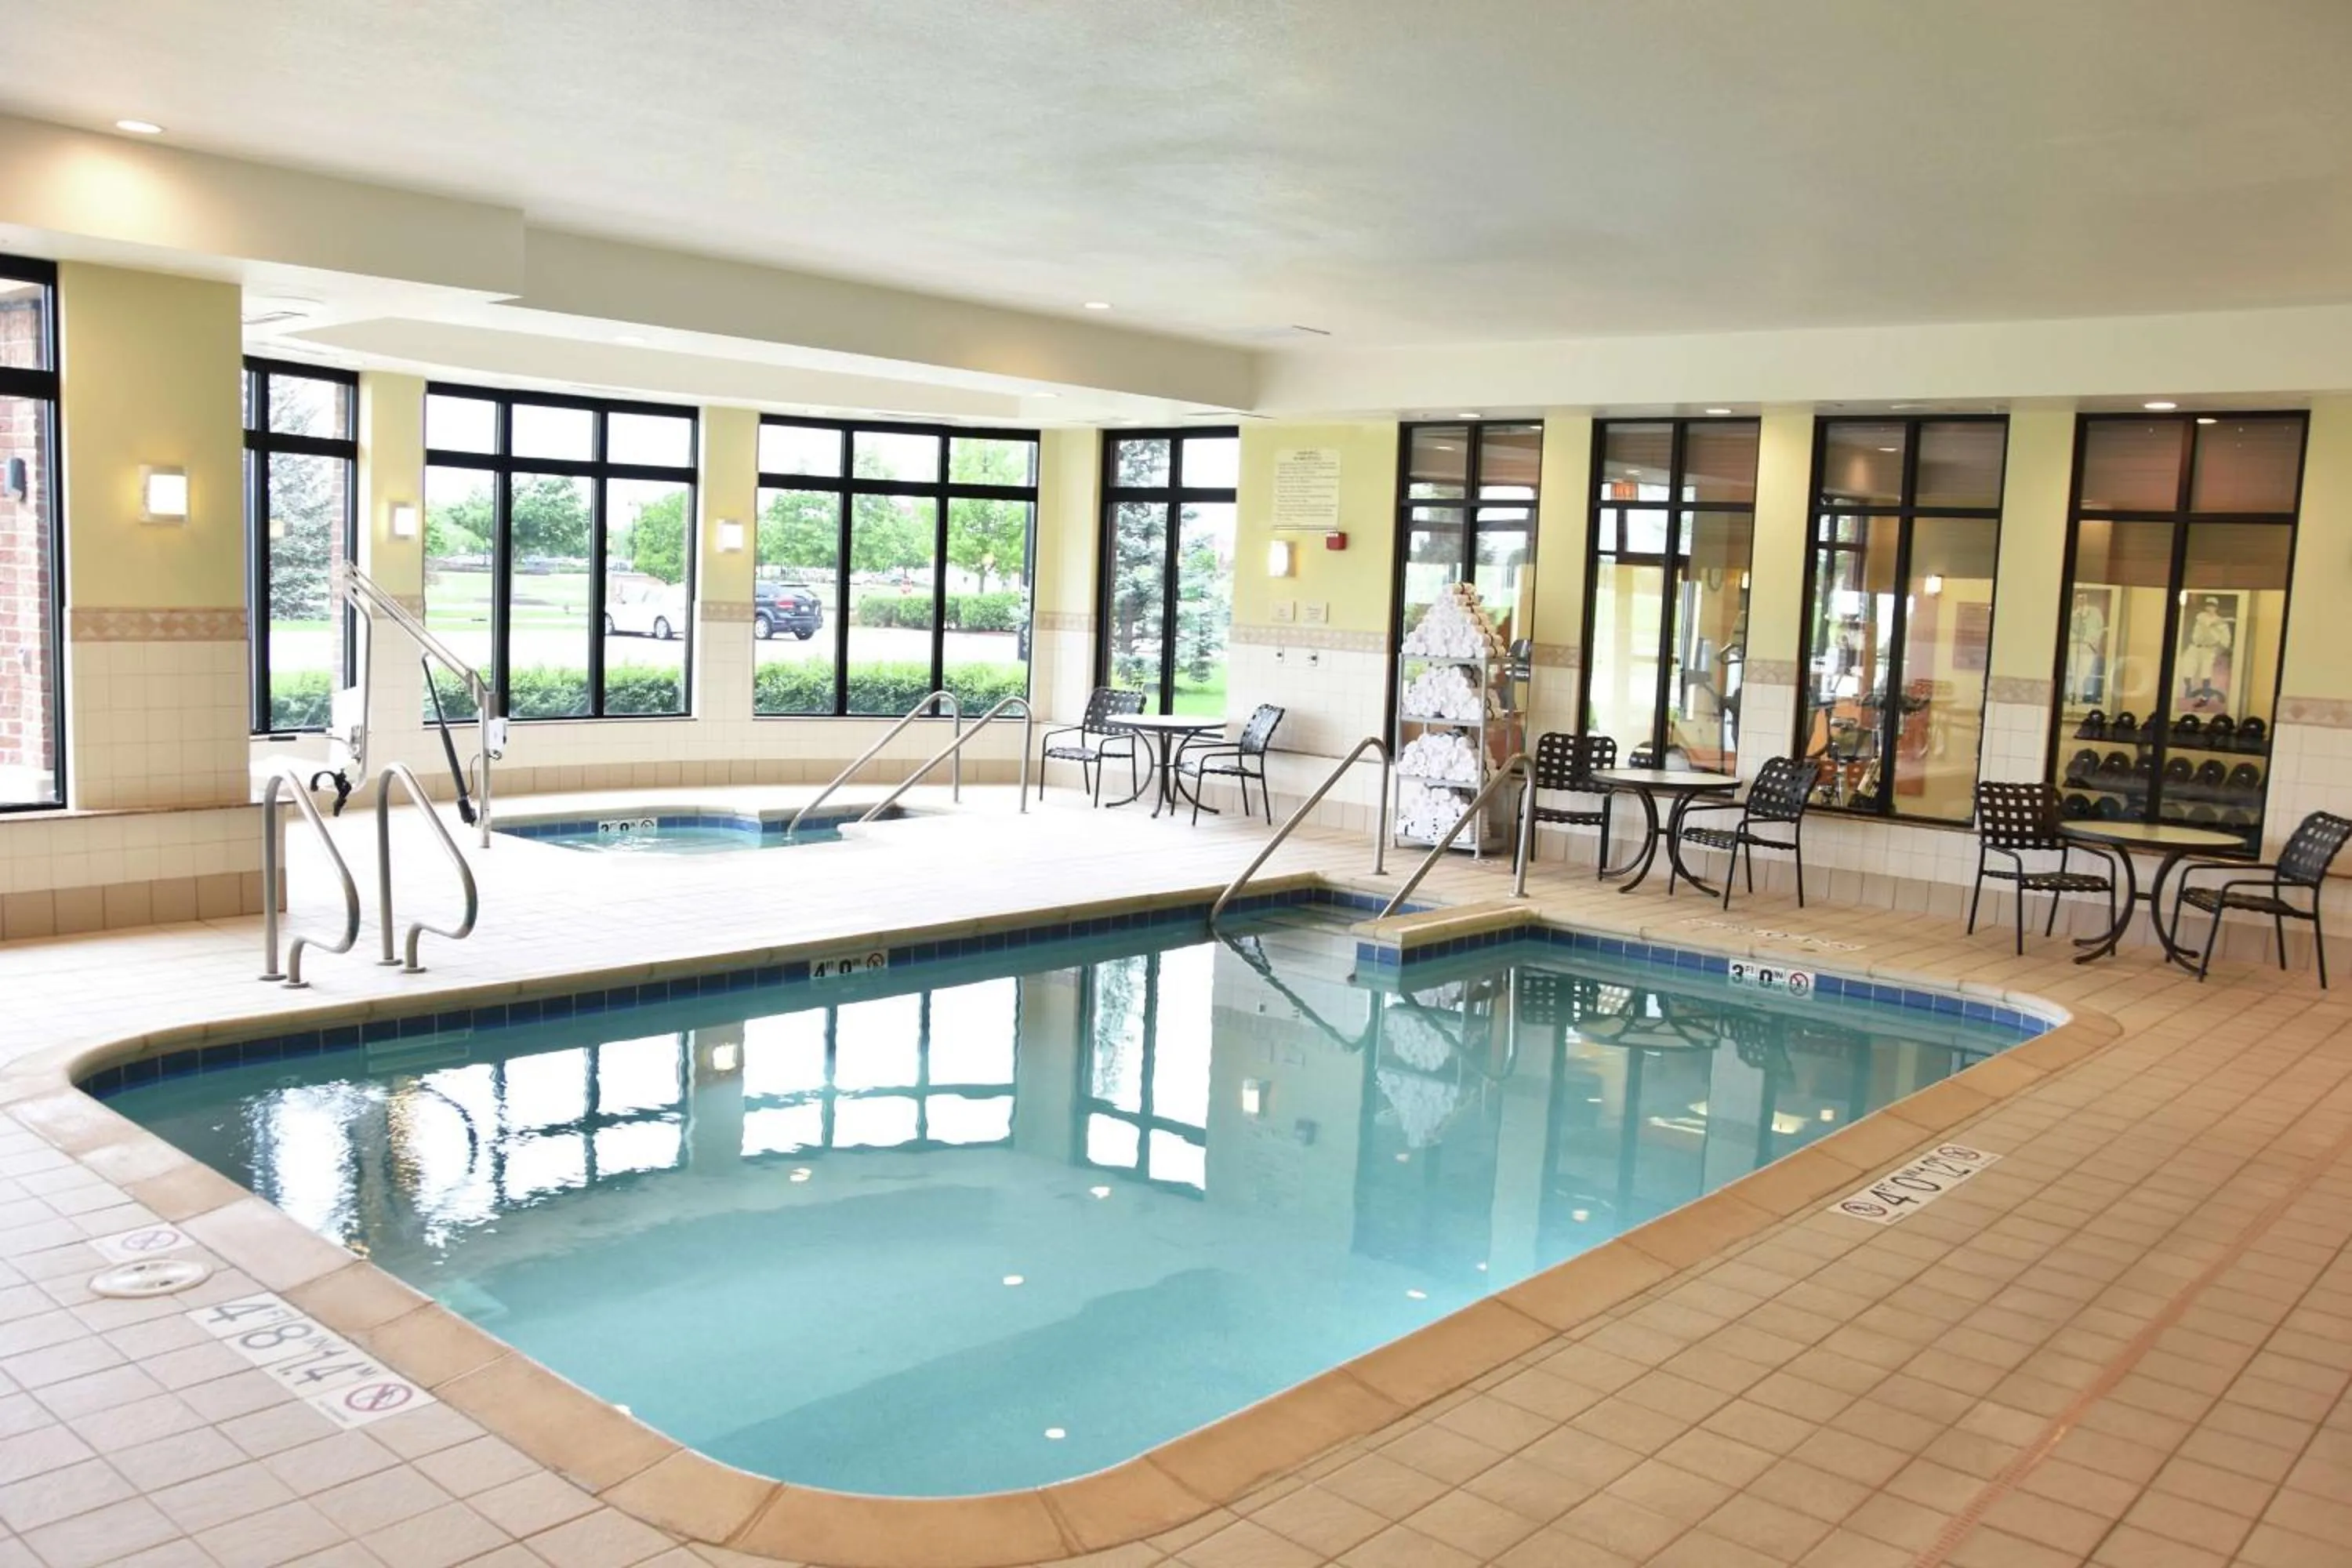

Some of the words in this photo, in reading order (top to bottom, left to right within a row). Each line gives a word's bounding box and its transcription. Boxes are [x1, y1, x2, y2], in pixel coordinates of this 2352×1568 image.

[1759, 968, 1773, 987] 0
[1890, 1176, 1942, 1192] 0
[1869, 1189, 1920, 1206] 4
[208, 1303, 277, 1323] 4
[238, 1323, 313, 1349] 8
